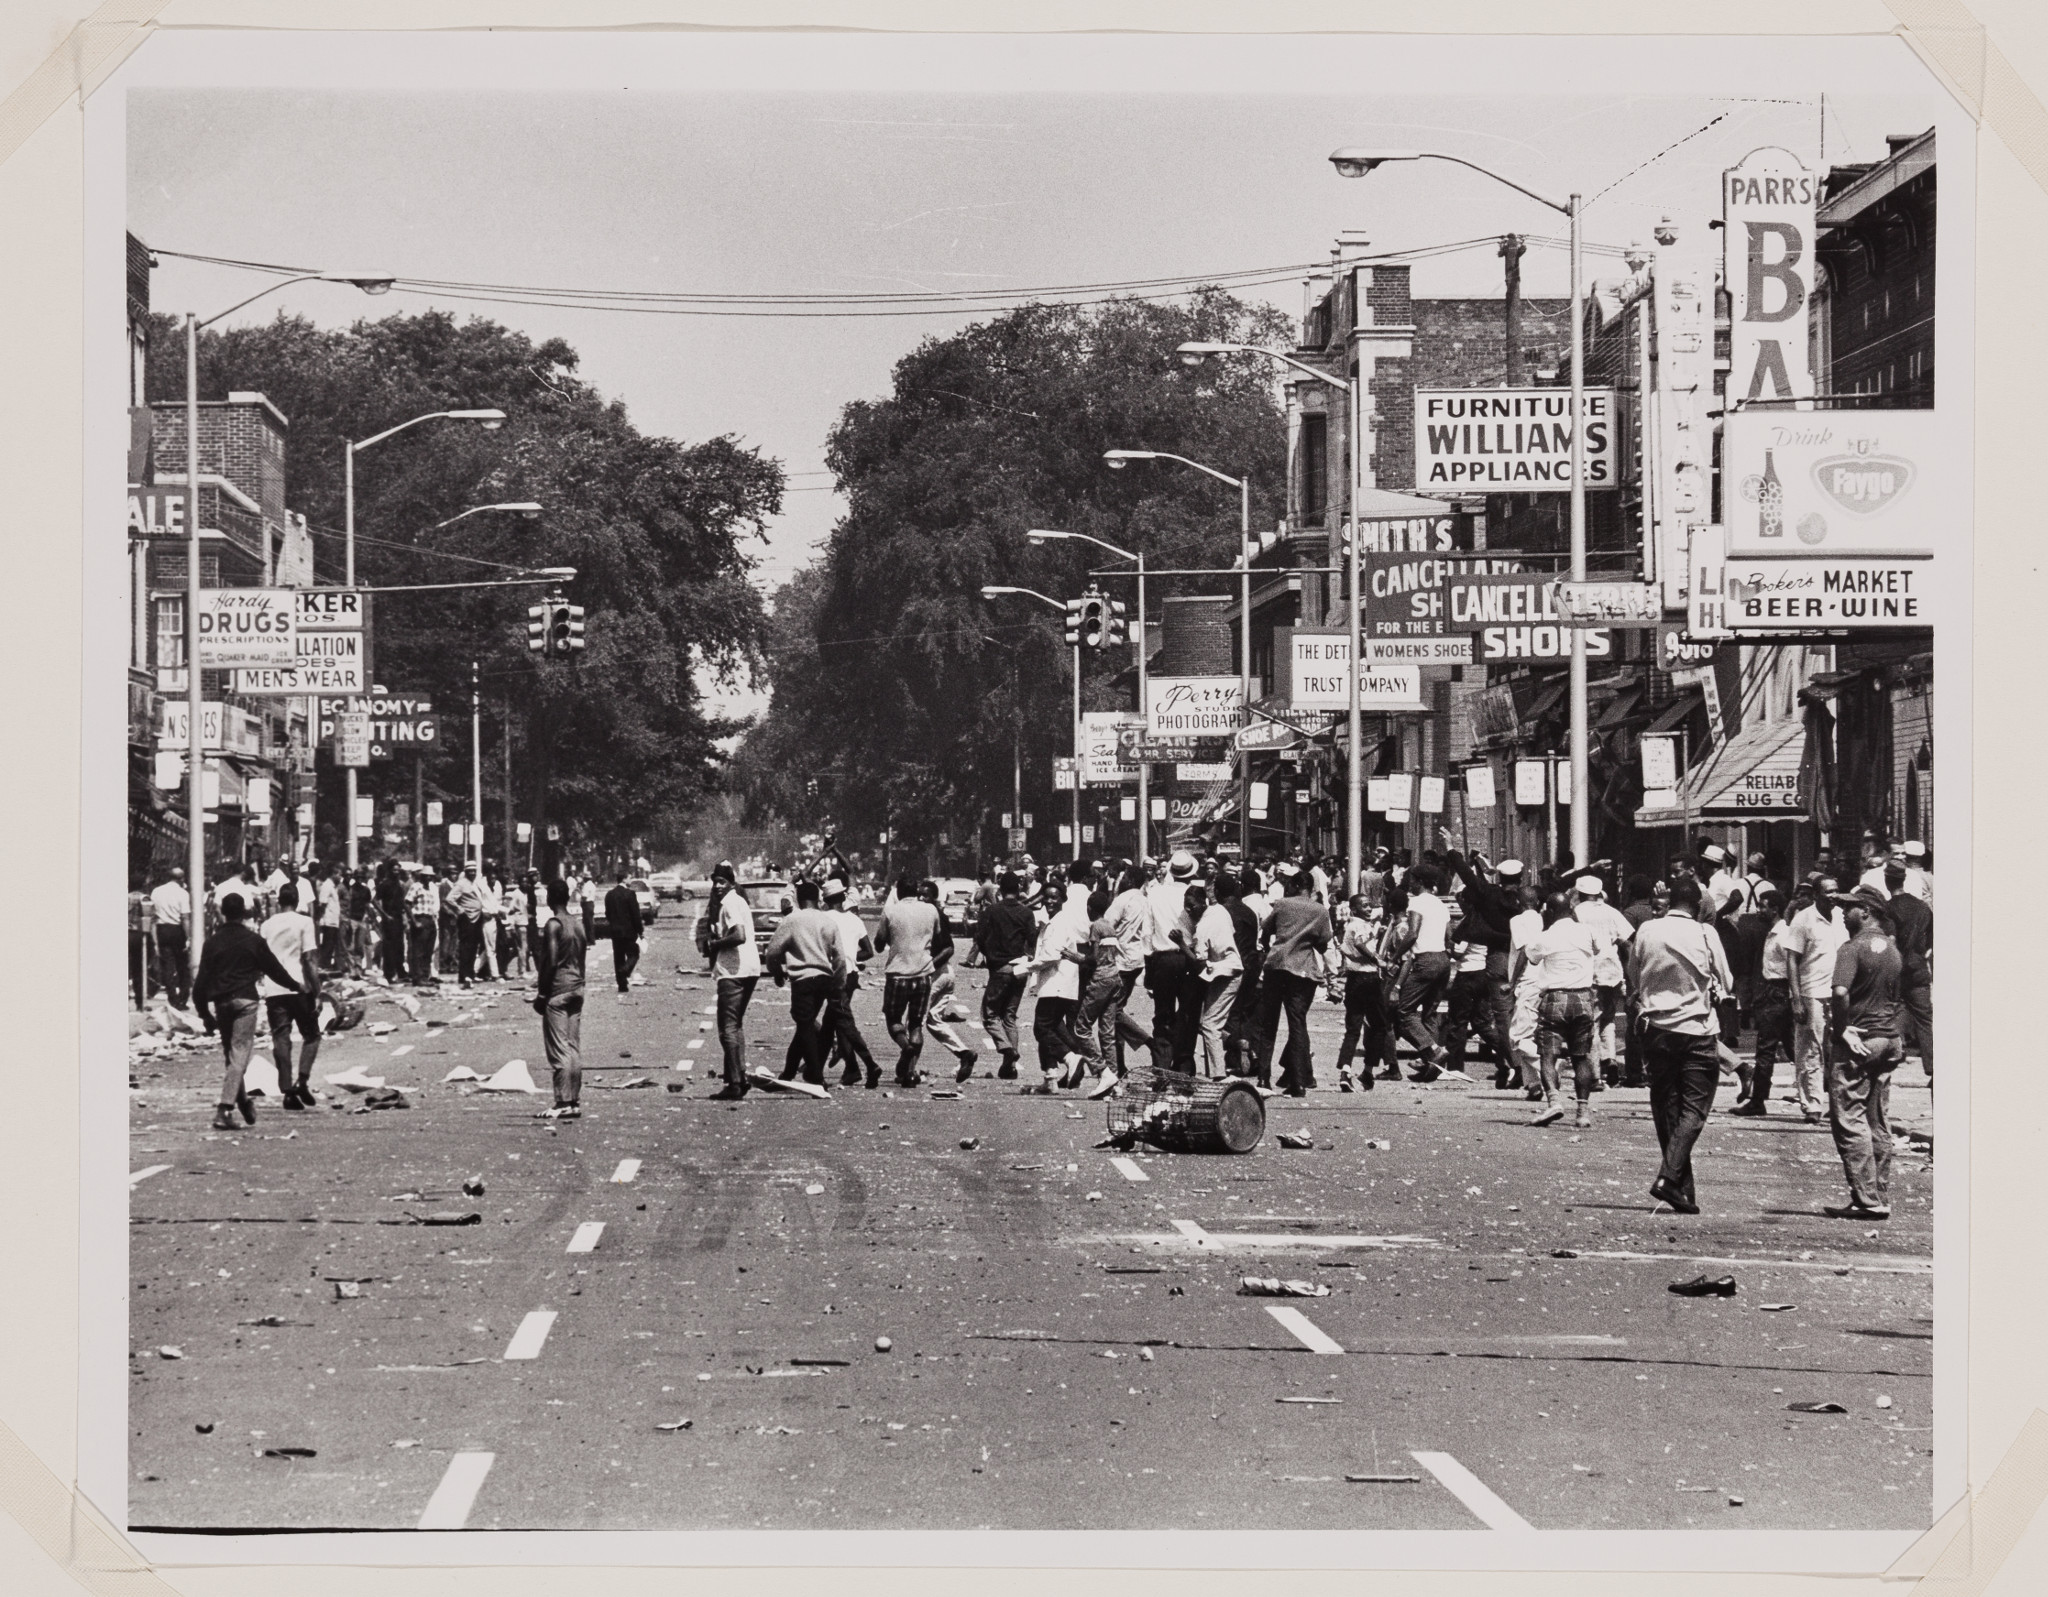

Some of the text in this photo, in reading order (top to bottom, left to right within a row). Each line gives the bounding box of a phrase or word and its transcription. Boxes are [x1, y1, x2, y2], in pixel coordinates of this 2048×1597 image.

[1731, 177, 1812, 205] PARR'S
[1427, 421, 1608, 455] WILLIAMS
[1771, 426, 1833, 447] Drink
[1429, 459, 1607, 482] APPLIANCS
[1833, 467, 1895, 501] Faygo
[1824, 570, 1914, 594] MARKET
[210, 592, 274, 611] Hardy
[199, 612, 290, 633] DRUGS
[1376, 622, 1400, 634] FOR
[1405, 622, 1430, 634] THE
[199, 636, 289, 644] PRESCRIPTIONS
[217, 652, 246, 663] QUAKER
[1298, 644, 1350, 659] THE DET
[1374, 644, 1429, 658] WOMENS
[305, 670, 358, 688] WEAR
[1304, 677, 1409, 692] TRUST OMPANY
[1156, 683, 1242, 714] Perry
[321, 720, 435, 741] PTING
[1241, 726, 1271, 746] SHOE
[1736, 793, 1771, 806] RUG
